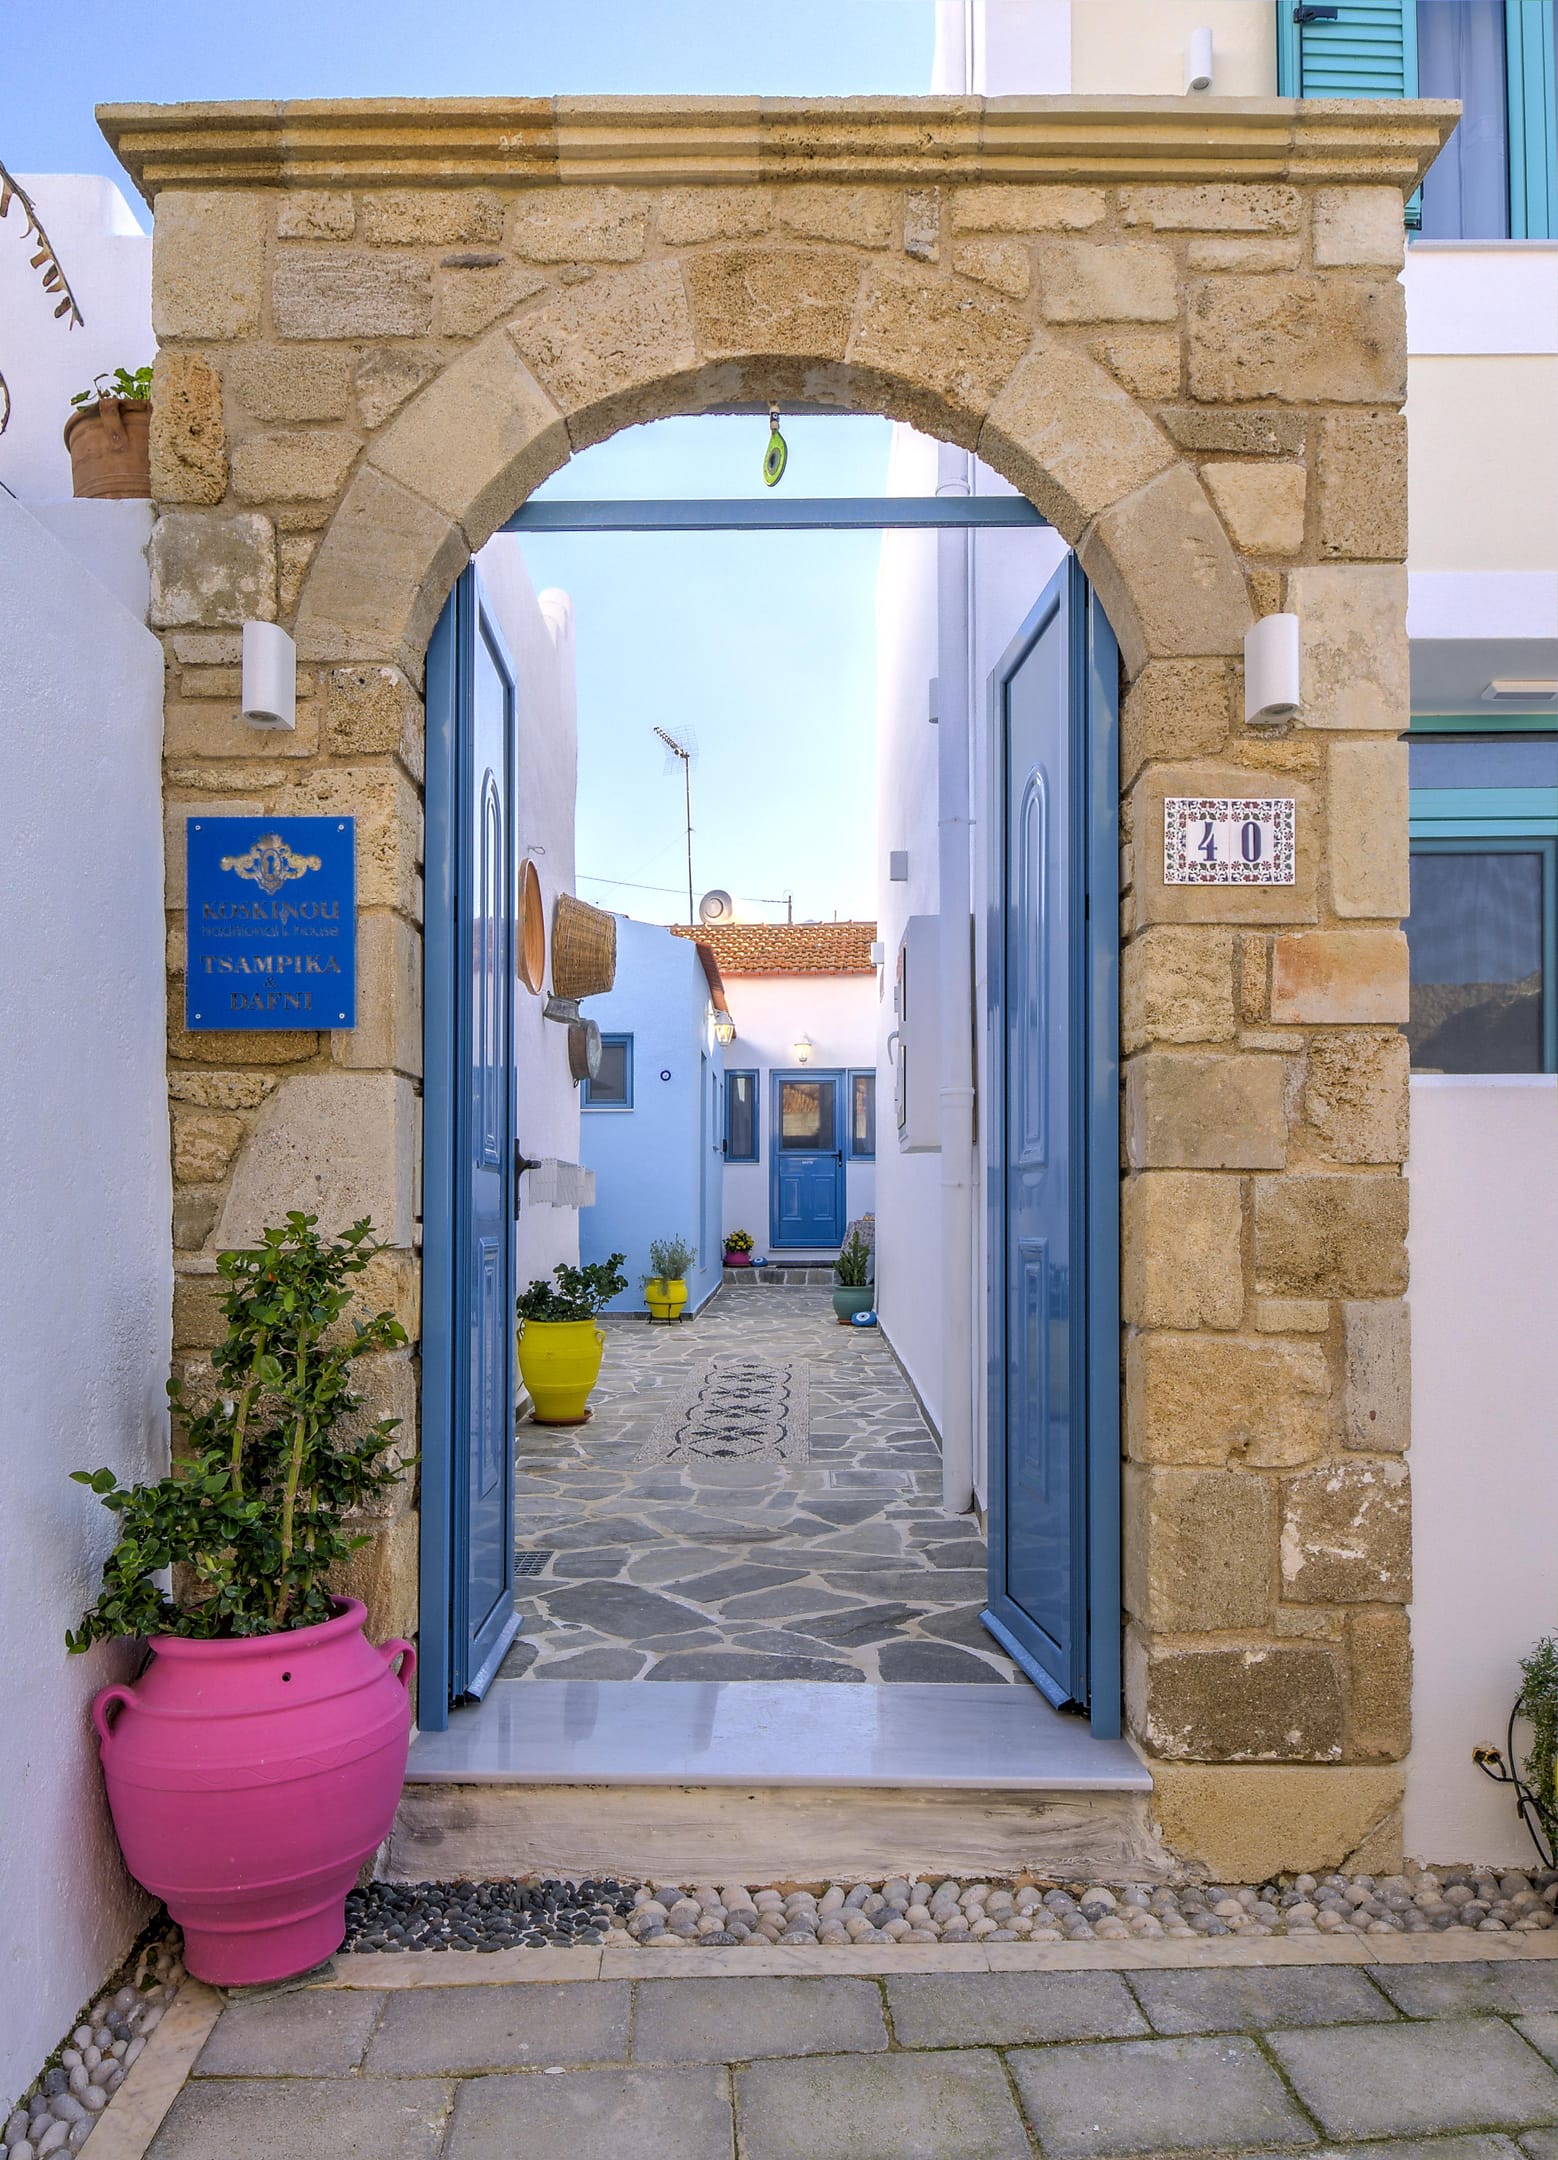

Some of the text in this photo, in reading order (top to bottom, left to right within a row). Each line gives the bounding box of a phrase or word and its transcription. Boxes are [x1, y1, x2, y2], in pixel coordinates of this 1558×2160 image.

[1197, 821, 1262, 862] 40
[202, 901, 339, 920] KOSKINOU
[201, 955, 341, 974] TSAMPIKA
[230, 992, 312, 1010] DAFNI
